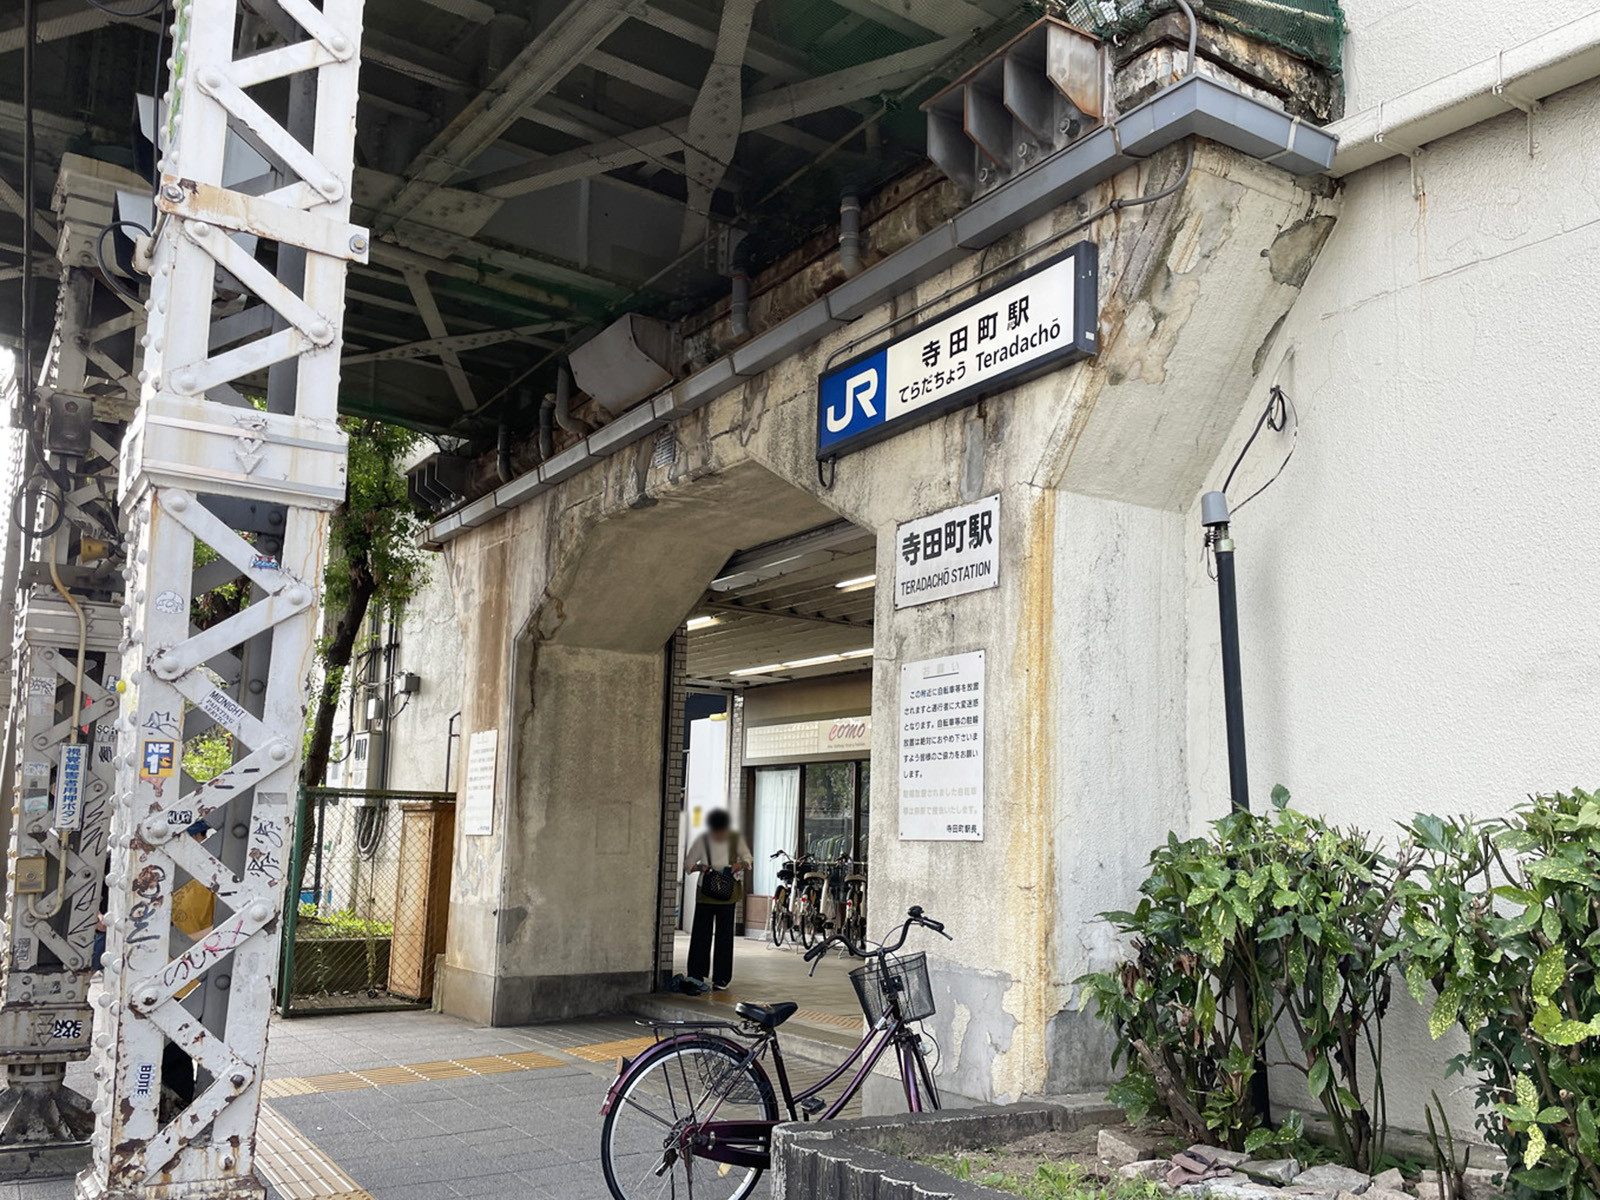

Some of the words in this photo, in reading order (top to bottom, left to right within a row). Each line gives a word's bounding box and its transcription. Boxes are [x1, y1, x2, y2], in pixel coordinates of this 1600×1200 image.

[921, 295, 1030, 368] 寺田町駅
[899, 361, 967, 404] てらだちょう
[975, 318, 1061, 372] Teradachō
[826, 367, 879, 433] JR
[901, 510, 993, 566] 寺田町駅
[901, 567, 950, 596] TERADACHŌ
[951, 560, 992, 583] STATION
[209, 690, 245, 718] MIDNIGHT
[148, 743, 171, 753] NZ
[61, 748, 81, 826] 視覚障害者用押ボタン
[903, 770, 923, 779] します。
[946, 824, 977, 834] 寺田町駅長
[53, 1028, 81, 1039] 246
